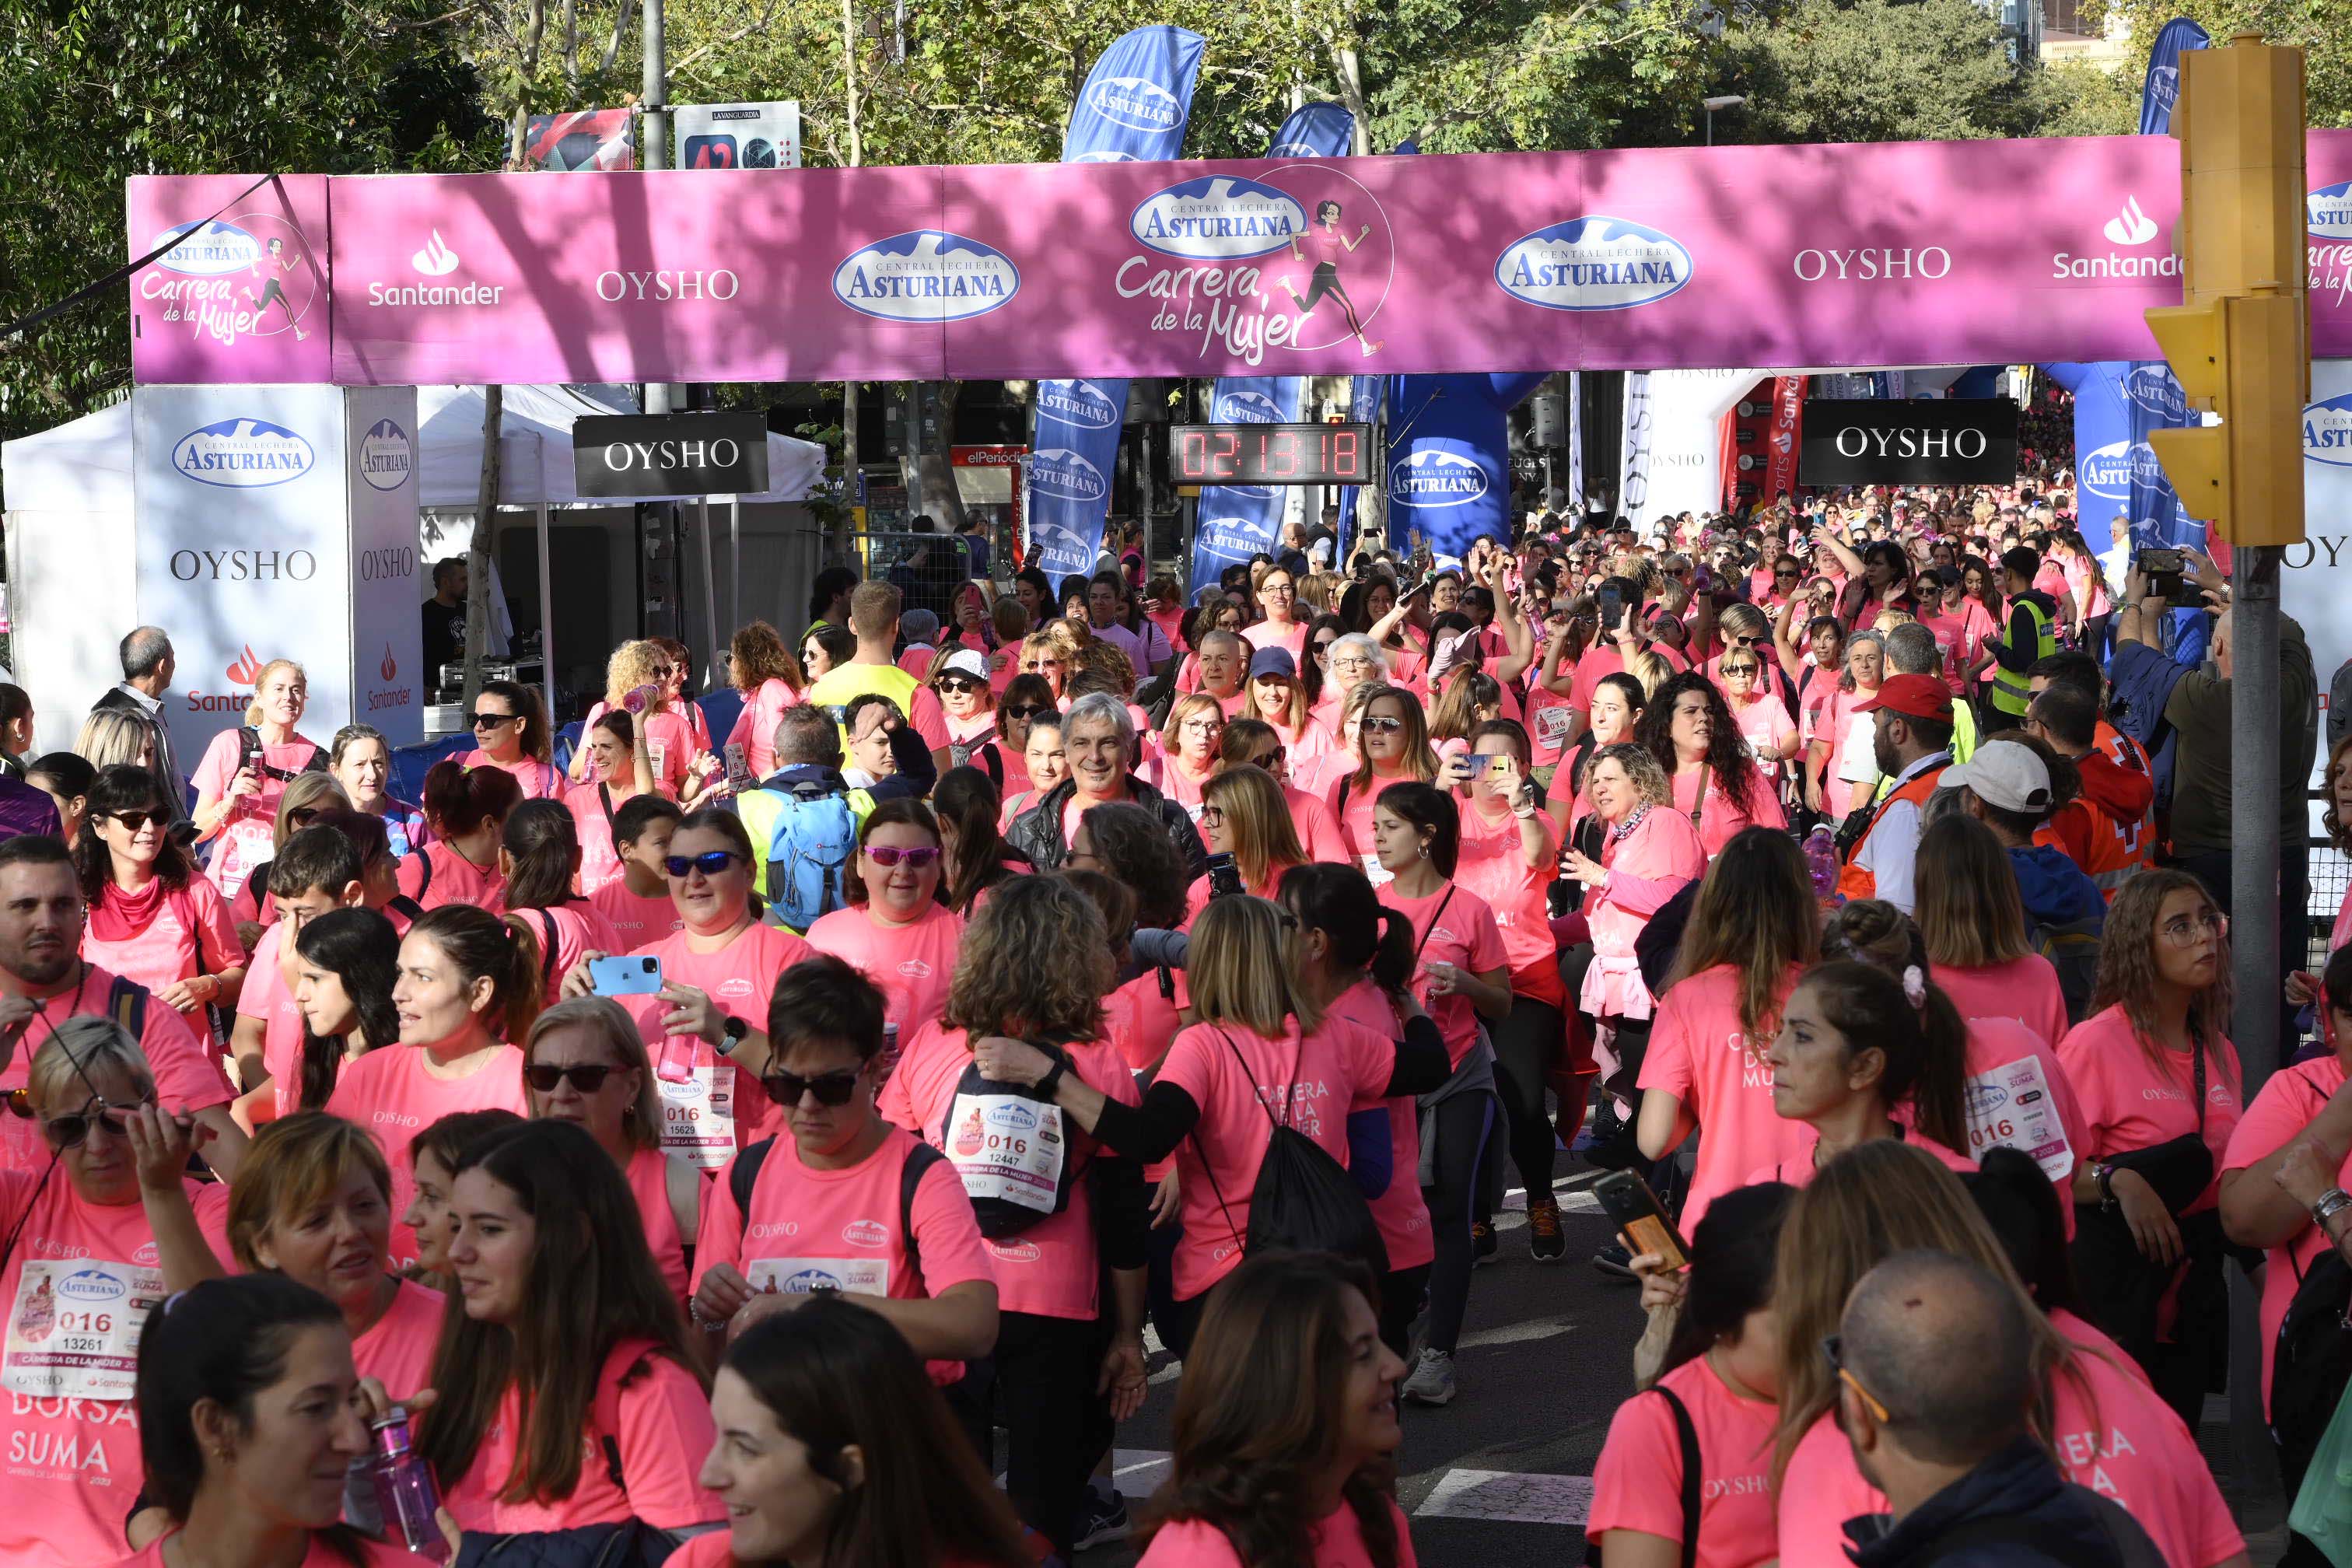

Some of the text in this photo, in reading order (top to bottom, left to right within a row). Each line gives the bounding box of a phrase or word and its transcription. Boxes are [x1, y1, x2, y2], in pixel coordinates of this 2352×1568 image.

[722, 110, 760, 119] VANGUARDIA
[1094, 86, 1174, 125] ASTURIANA
[1171, 203, 1288, 213] CENTRAL LECHERA
[1143, 208, 1293, 239] ASTURIANA
[1541, 248, 1671, 259] CENTRAL LECHERA
[1794, 246, 1951, 281] OYSHO
[2053, 253, 2183, 278] Santand
[2308, 244, 2352, 267] arre
[876, 261, 935, 271] CENTRAL
[1115, 255, 1261, 298] Carrera
[1510, 253, 1678, 287] ASTURIANA
[140, 271, 233, 299] Carrera
[596, 269, 739, 301] OYSHO
[847, 264, 1006, 299] ASTURIANA
[2326, 268, 2340, 289] la
[369, 282, 504, 306] Santander
[163, 298, 268, 346] de la Mujer
[1150, 293, 1315, 366] de la Mujer
[1036, 387, 1110, 423] ASTURIANA
[604, 439, 740, 471] OYSHO
[1836, 427, 1986, 459] OYSHO
[183, 444, 305, 471] ASTURIANA
[363, 446, 409, 473] ASTURIANA
[968, 450, 1021, 464] elPeriódi
[1032, 467, 1100, 495] STURIANA
[1393, 474, 1481, 495] ASTURIANA
[1201, 527, 1271, 555] ASTURIANA
[170, 550, 317, 581] OYSHO
[362, 546, 413, 581] OYSHO
[1040, 546, 1087, 569] URIANA
[368, 685, 411, 711] Santander
[1549, 720, 1566, 730] 016
[667, 1108, 699, 1121] 016
[990, 1111, 1034, 1127] ASTURIANA
[1294, 1101, 1317, 1121] LA
[670, 1125, 695, 1134] 15629
[1970, 1118, 2014, 1147] 016
[987, 1135, 1027, 1153] 016
[989, 1153, 1020, 1167] 12447
[1011, 1171, 1033, 1181] MUJER
[1013, 1186, 1048, 1202] Santander
[994, 1246, 1036, 1258] ASTURIANA
[63, 1283, 121, 1294] ASTURIANA
[60, 1311, 113, 1332] 016
[63, 1338, 103, 1351] 13261
[65, 1356, 79, 1365] DE
[80, 1357, 94, 1366] LA
[12, 1391, 138, 1428] DORSA
[9, 1430, 109, 1473] SUMA
